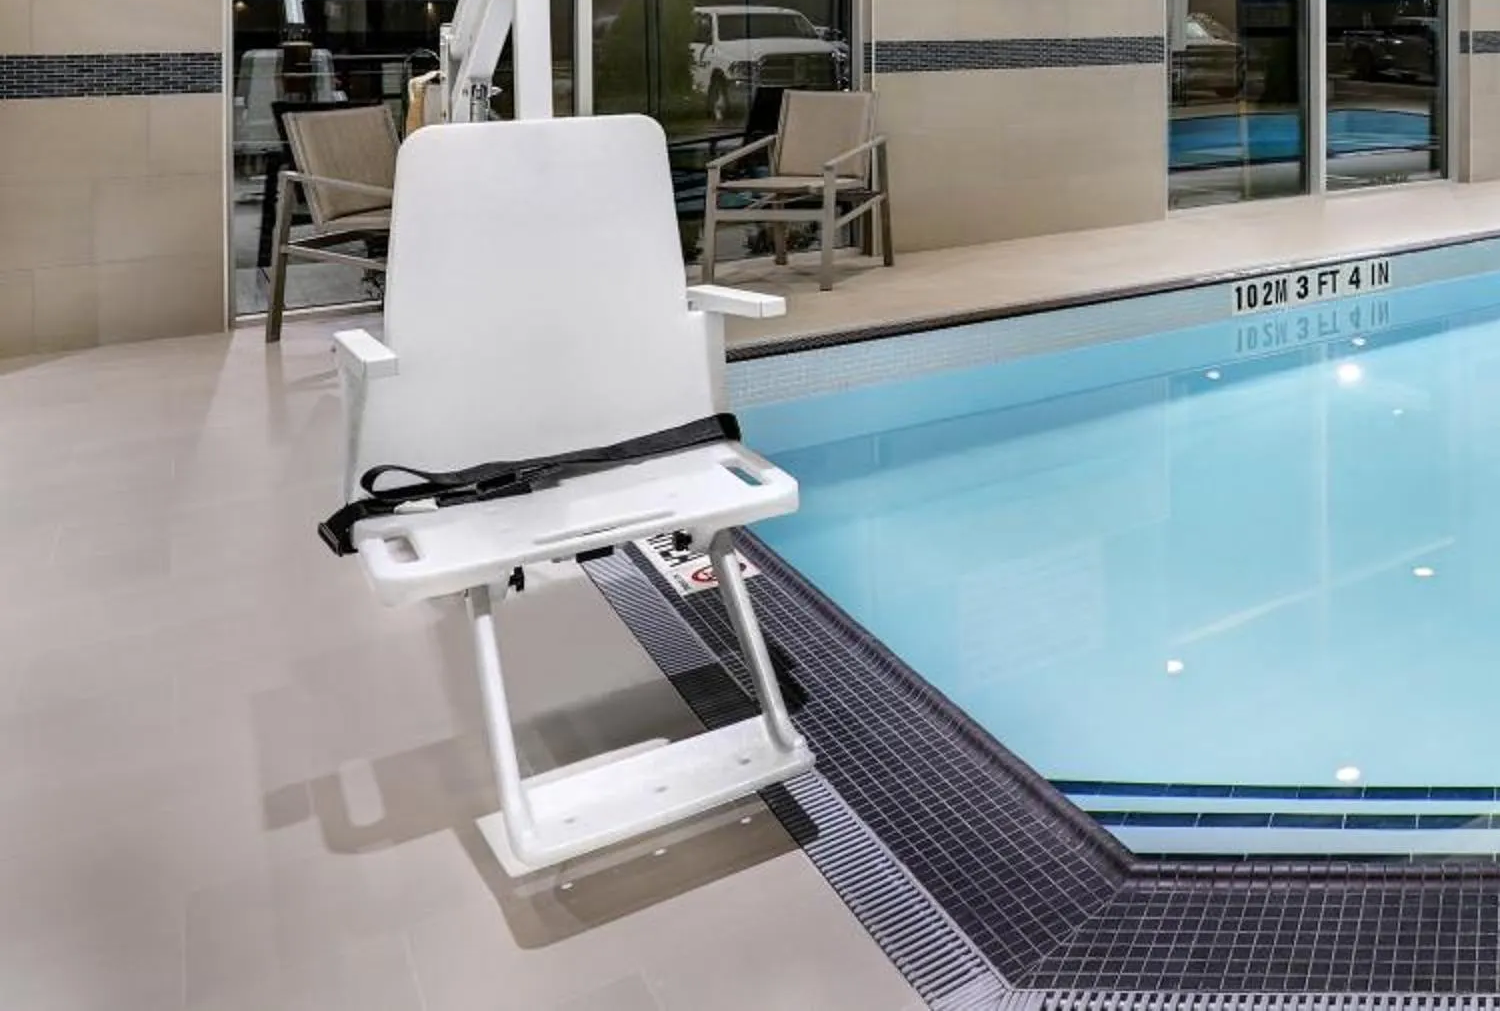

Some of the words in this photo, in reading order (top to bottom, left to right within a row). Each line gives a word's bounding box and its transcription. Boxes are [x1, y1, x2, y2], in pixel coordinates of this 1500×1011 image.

[1234, 278, 1288, 311] 102M
[1296, 275, 1309, 299] 3
[1317, 270, 1340, 295] FT
[1349, 265, 1360, 289] 4
[1371, 260, 1389, 286] IN
